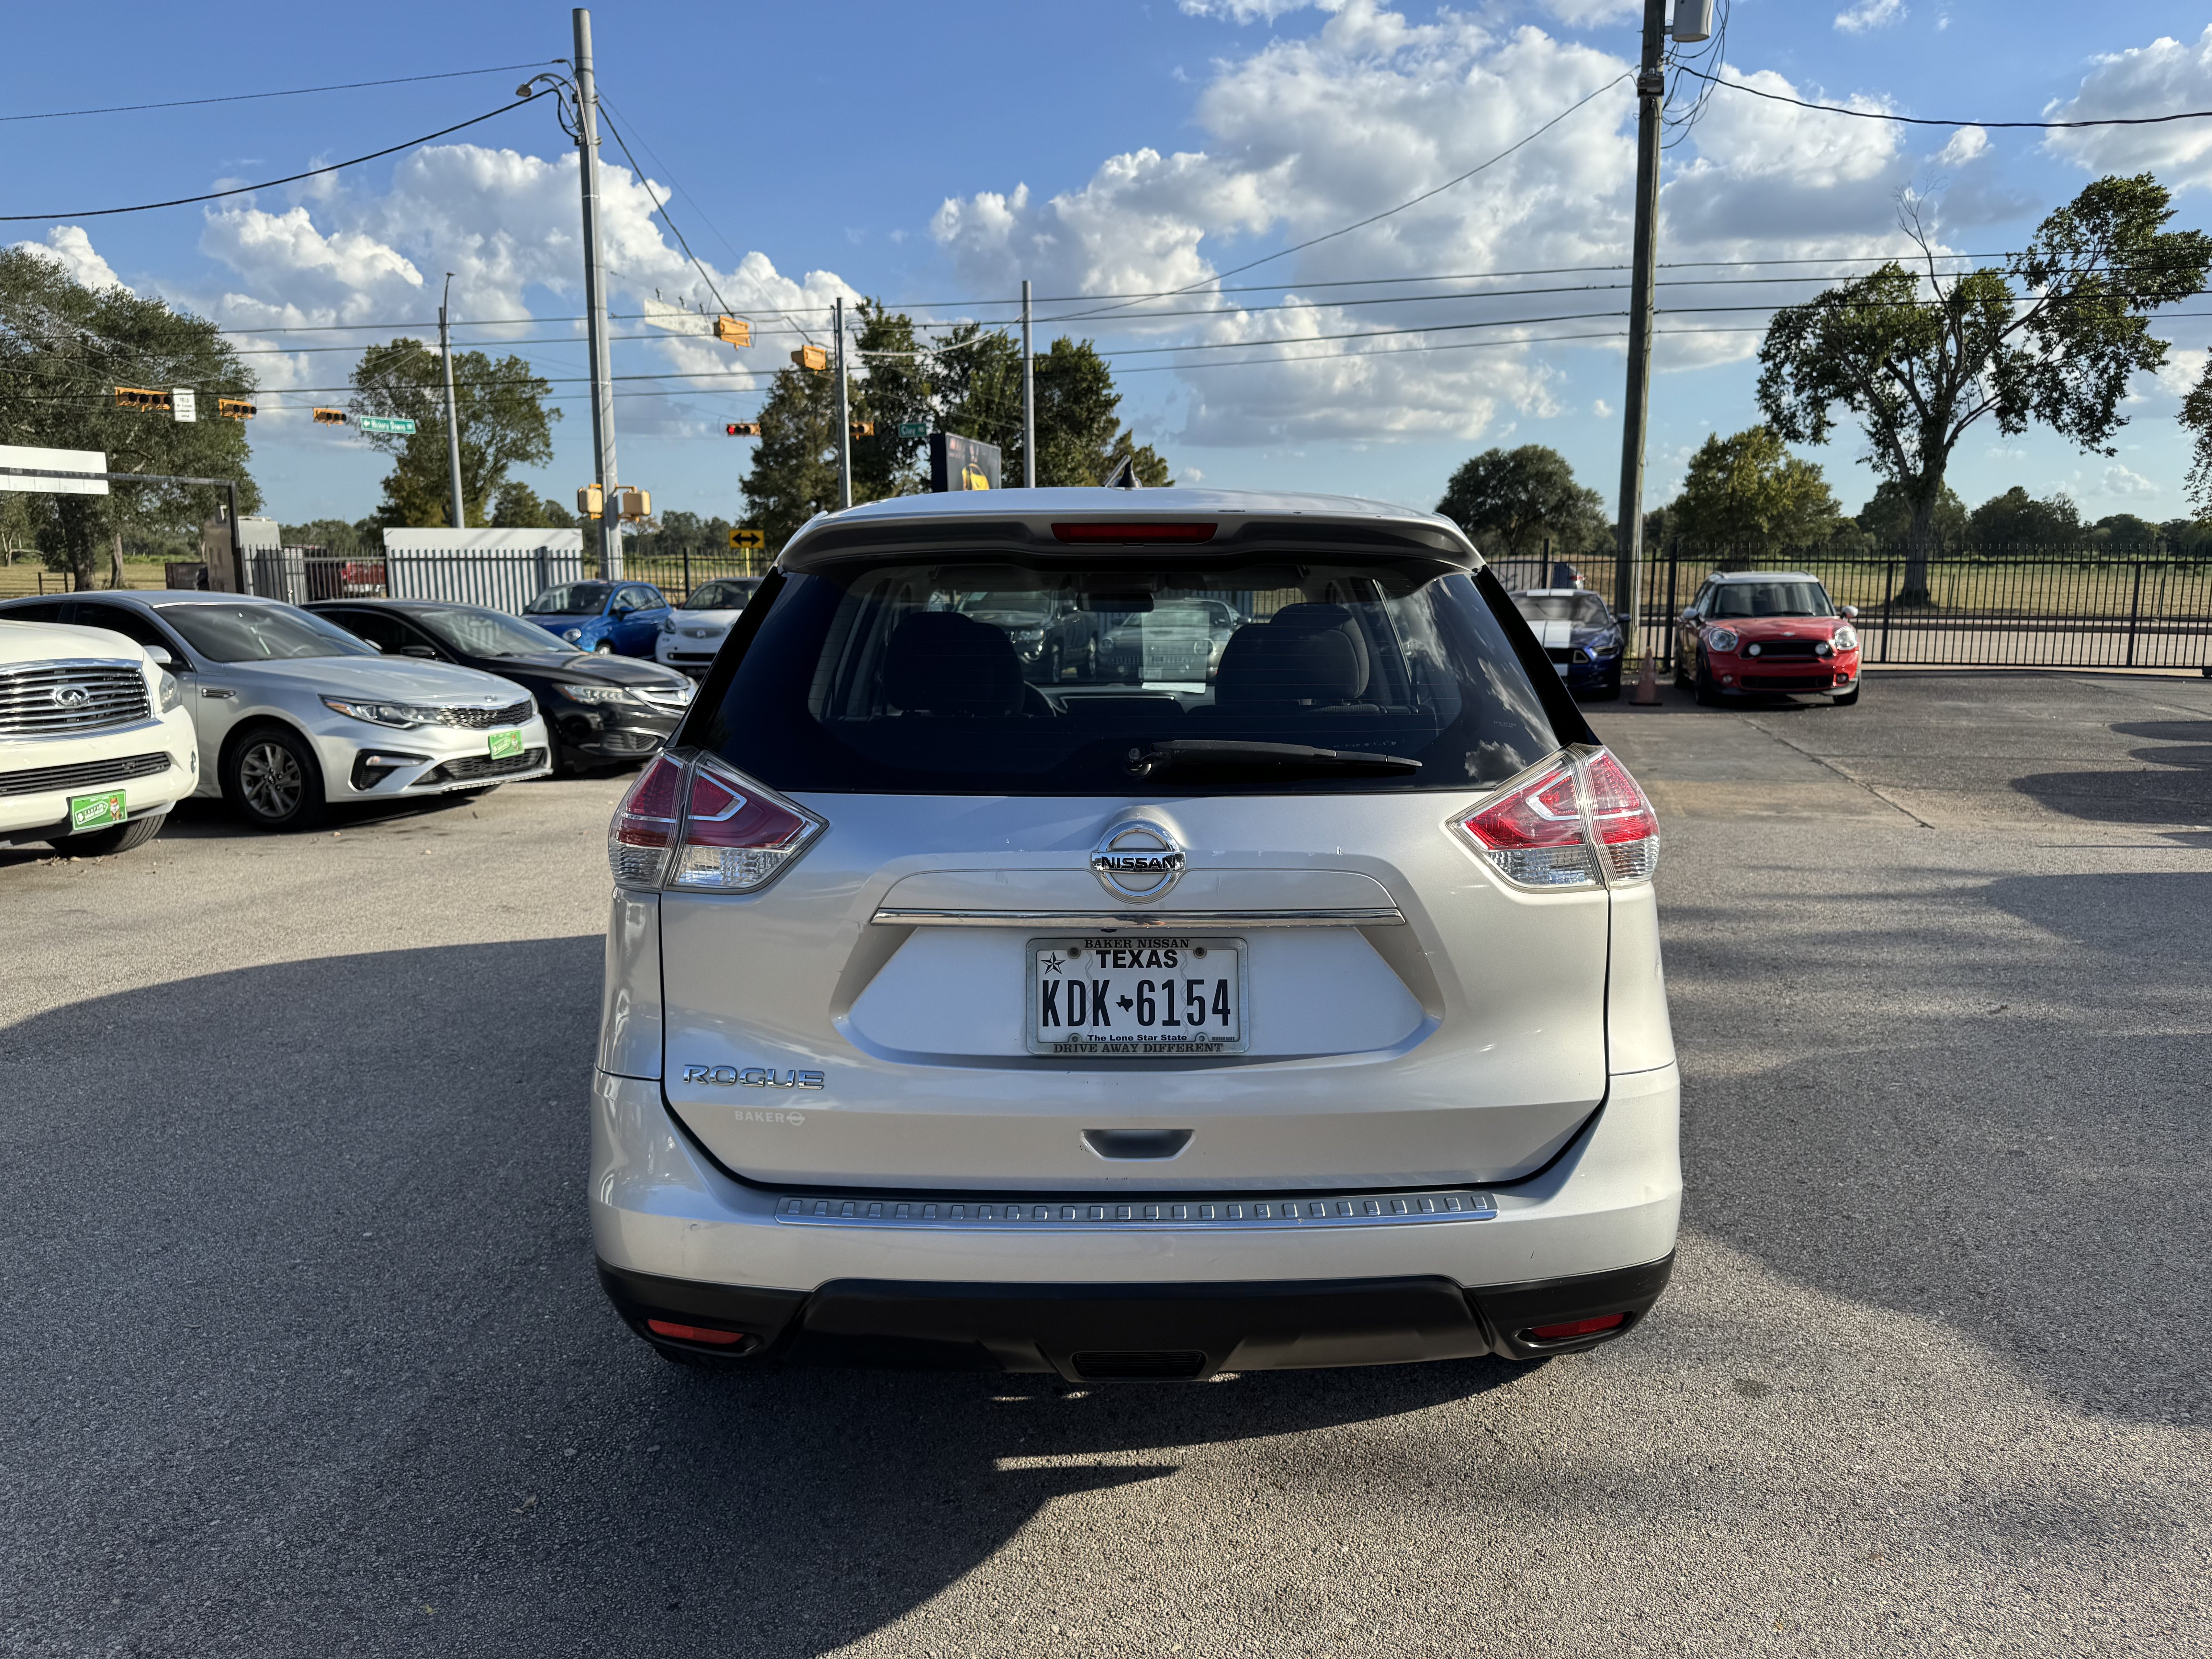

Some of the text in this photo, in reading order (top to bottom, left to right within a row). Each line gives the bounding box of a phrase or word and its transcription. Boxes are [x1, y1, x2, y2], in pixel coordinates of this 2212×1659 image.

[1101, 856, 1175, 869] NISSAN
[1084, 939, 1190, 948] BAKER NISSAN
[1096, 949, 1178, 968] TEXAS
[1053, 1043, 1223, 1053] DRIVE AWAY DIFFERENT
[684, 1065, 825, 1089] ROGUE
[735, 1110, 785, 1123] BAKER
